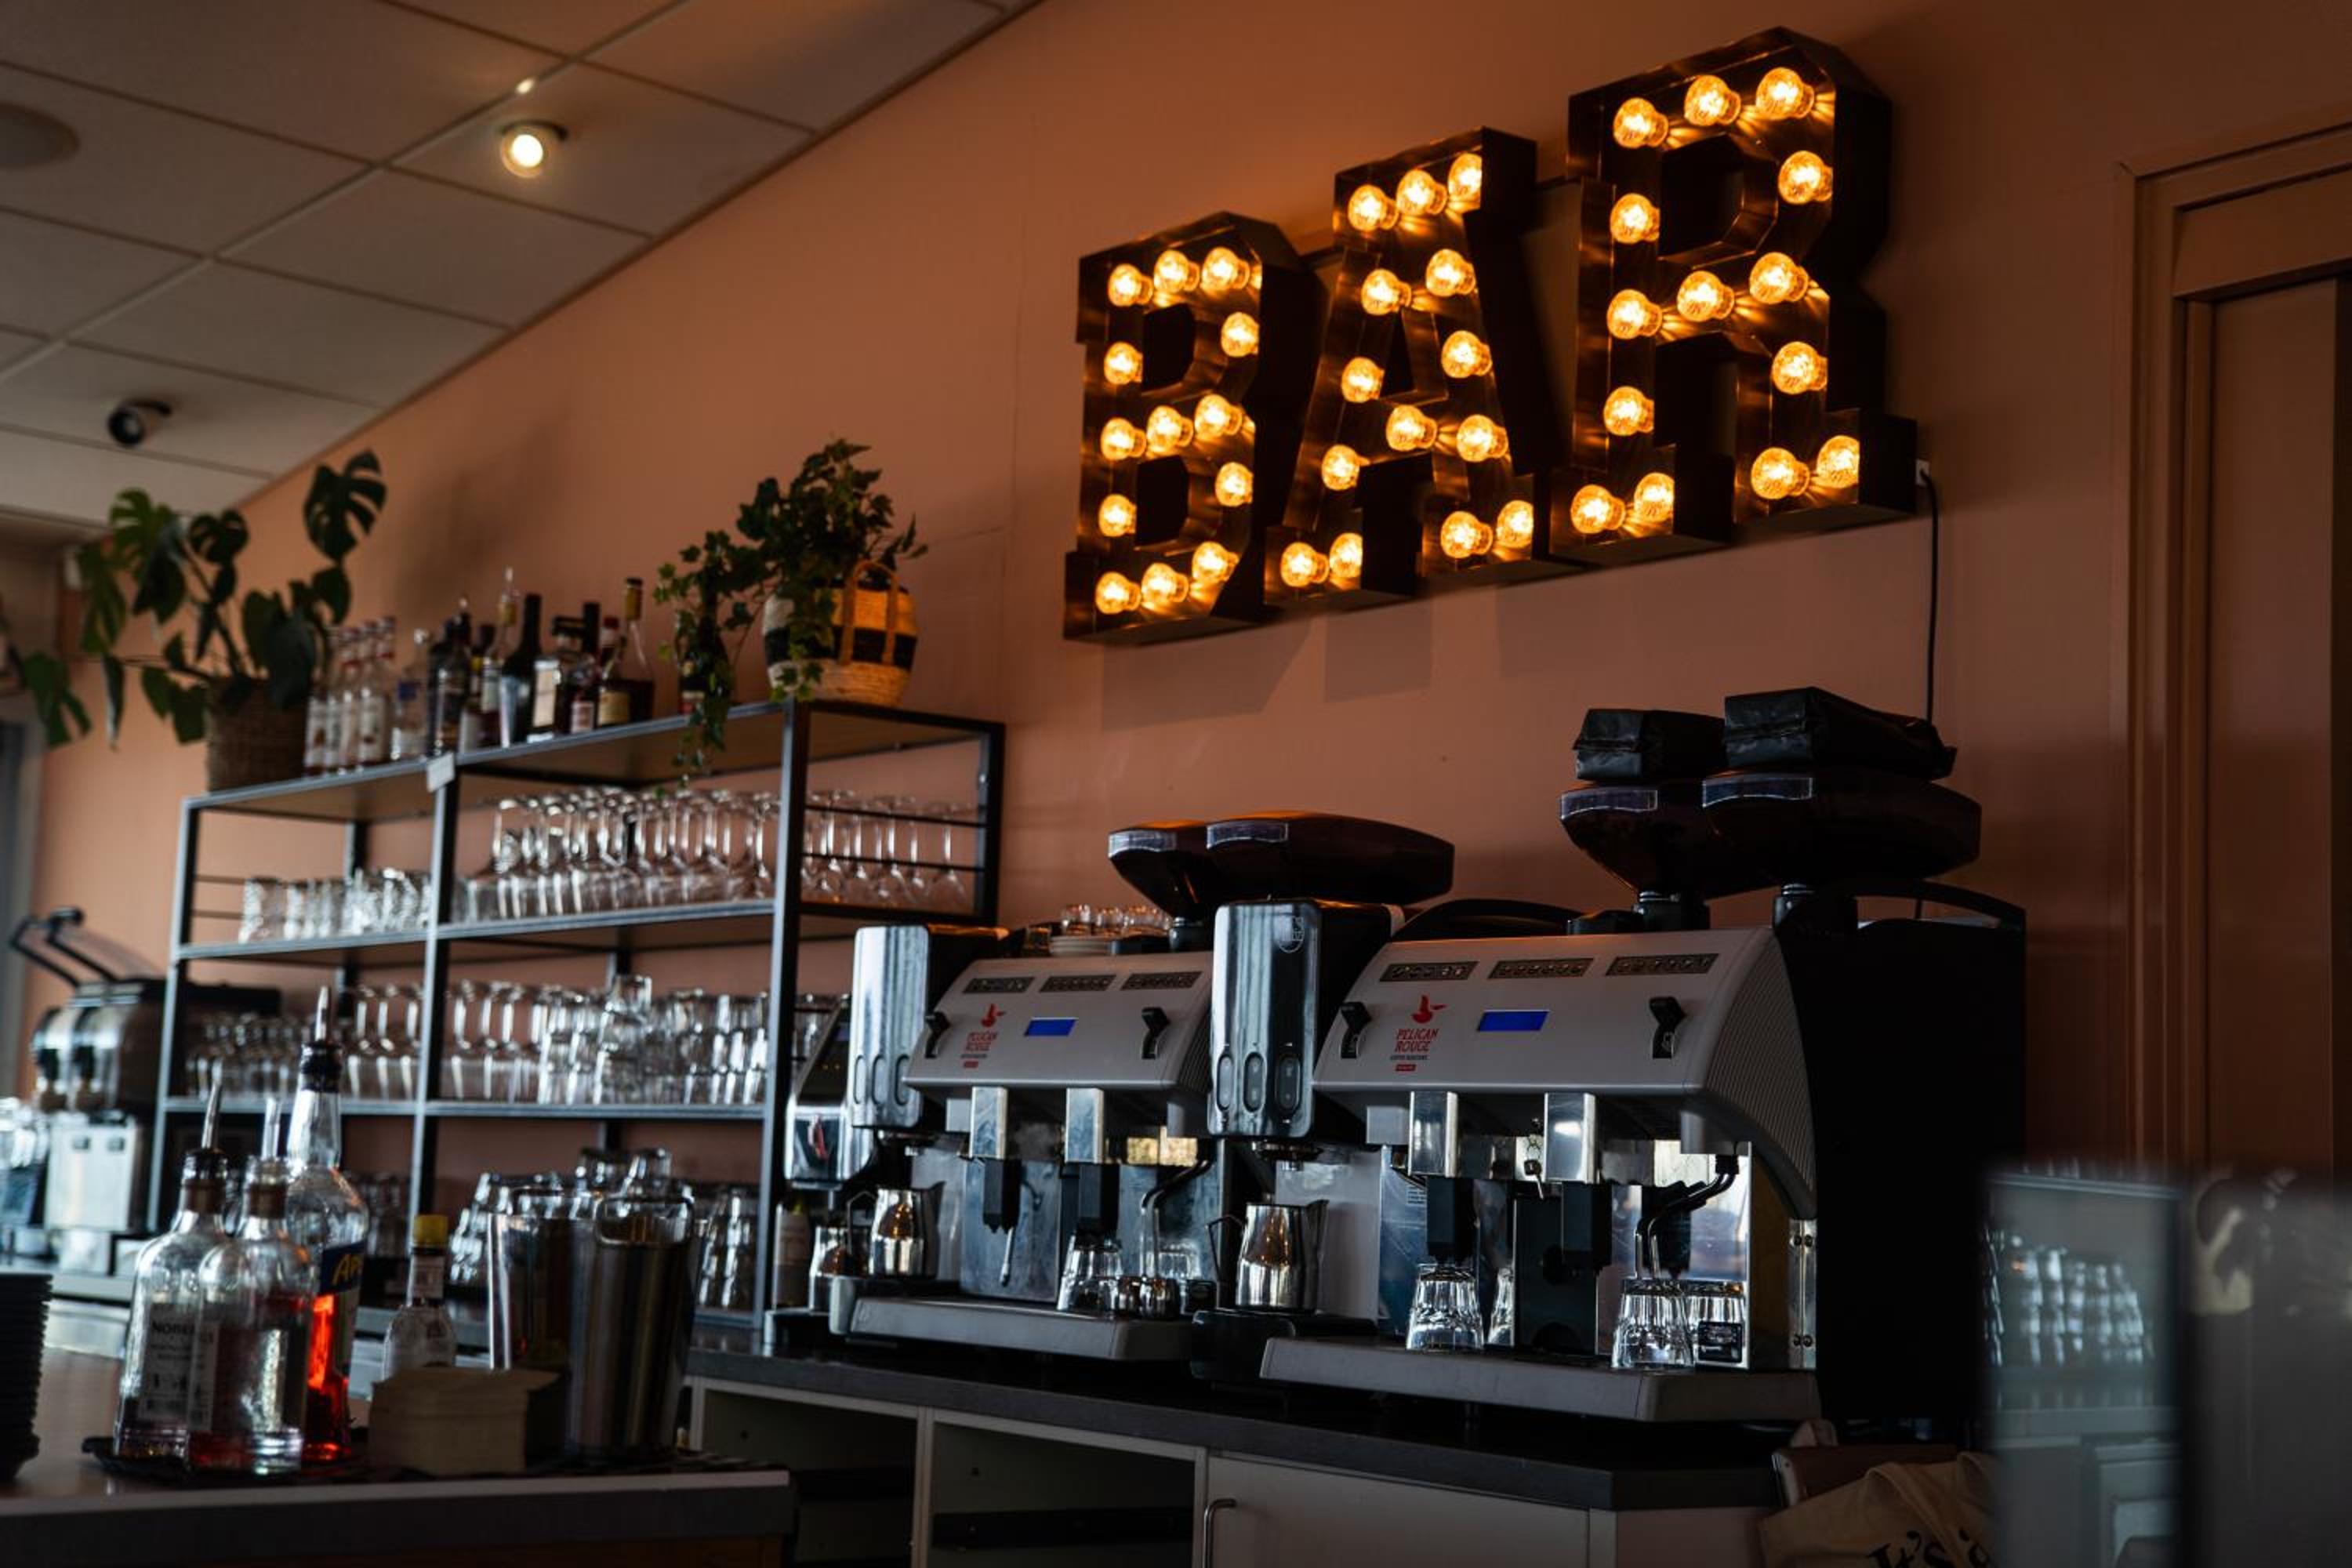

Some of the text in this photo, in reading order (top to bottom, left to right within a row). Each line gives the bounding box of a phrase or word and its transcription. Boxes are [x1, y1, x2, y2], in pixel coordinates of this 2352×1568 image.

[1065, 27, 1915, 644] BAR
[1396, 1028, 1439, 1041] PELICAN
[1395, 1040, 1431, 1052] ROUGE
